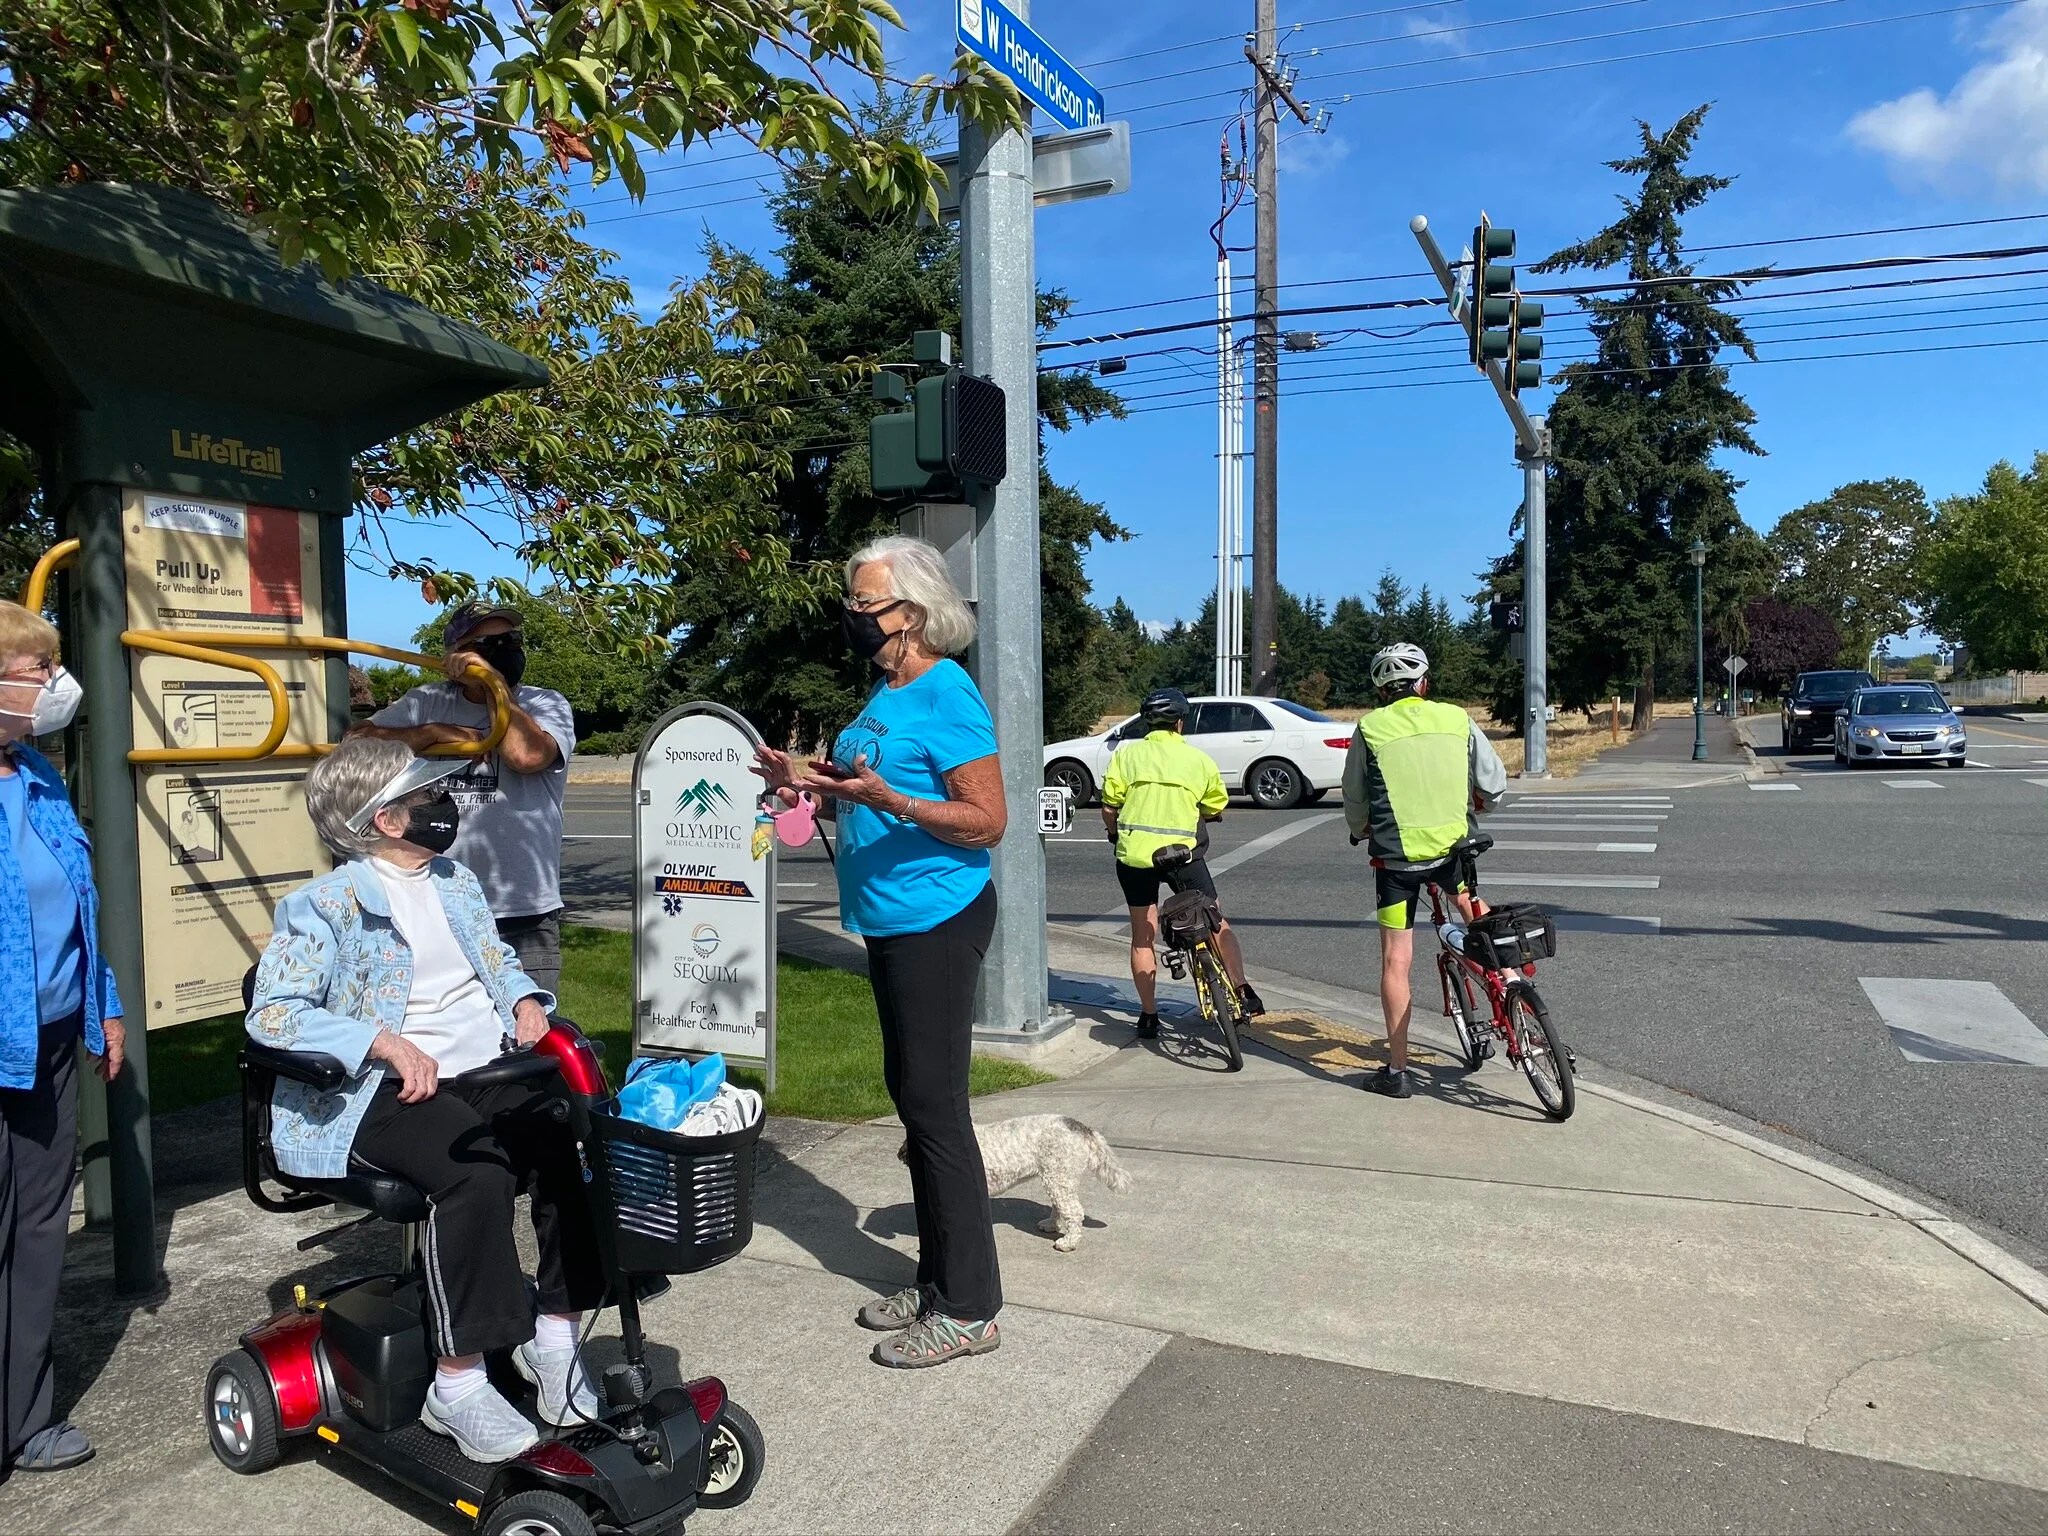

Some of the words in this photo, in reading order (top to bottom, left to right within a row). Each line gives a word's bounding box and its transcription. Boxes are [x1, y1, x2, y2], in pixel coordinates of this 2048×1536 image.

[986, 6, 999, 54] W
[1004, 23, 1083, 127] Hendrickson
[171, 429, 282, 474] LifeTrail
[149, 505, 170, 519] KEEP
[172, 503, 206, 515] SEQUIM
[208, 509, 240, 530] PURPLE
[156, 559, 190, 579] Pull
[196, 562, 221, 584] Up
[156, 581, 171, 592] For
[172, 583, 218, 596] Wheelchair
[220, 586, 243, 597] Users
[158, 609, 174, 618] How
[174, 610, 183, 618] To
[184, 610, 198, 618] Use
[162, 681, 180, 689] Level
[665, 746, 723, 764] Sponsored
[727, 748, 742, 766] By
[167, 780, 184, 788] Level
[469, 793, 497, 804] PARK
[665, 822, 742, 841] OLYMPIC
[665, 839, 705, 849] MEDICAL
[707, 841, 742, 850] CENTER
[663, 863, 716, 878] OLYMPIC
[171, 887, 186, 896] Tips
[662, 878, 731, 895] AMBULANCE
[731, 885, 747, 896] Inc.
[673, 962, 738, 984] SEQUIM
[690, 1000, 707, 1014] For
[709, 1002, 718, 1015] A
[652, 1012, 697, 1029] Healthier
[699, 1017, 757, 1039] Community
